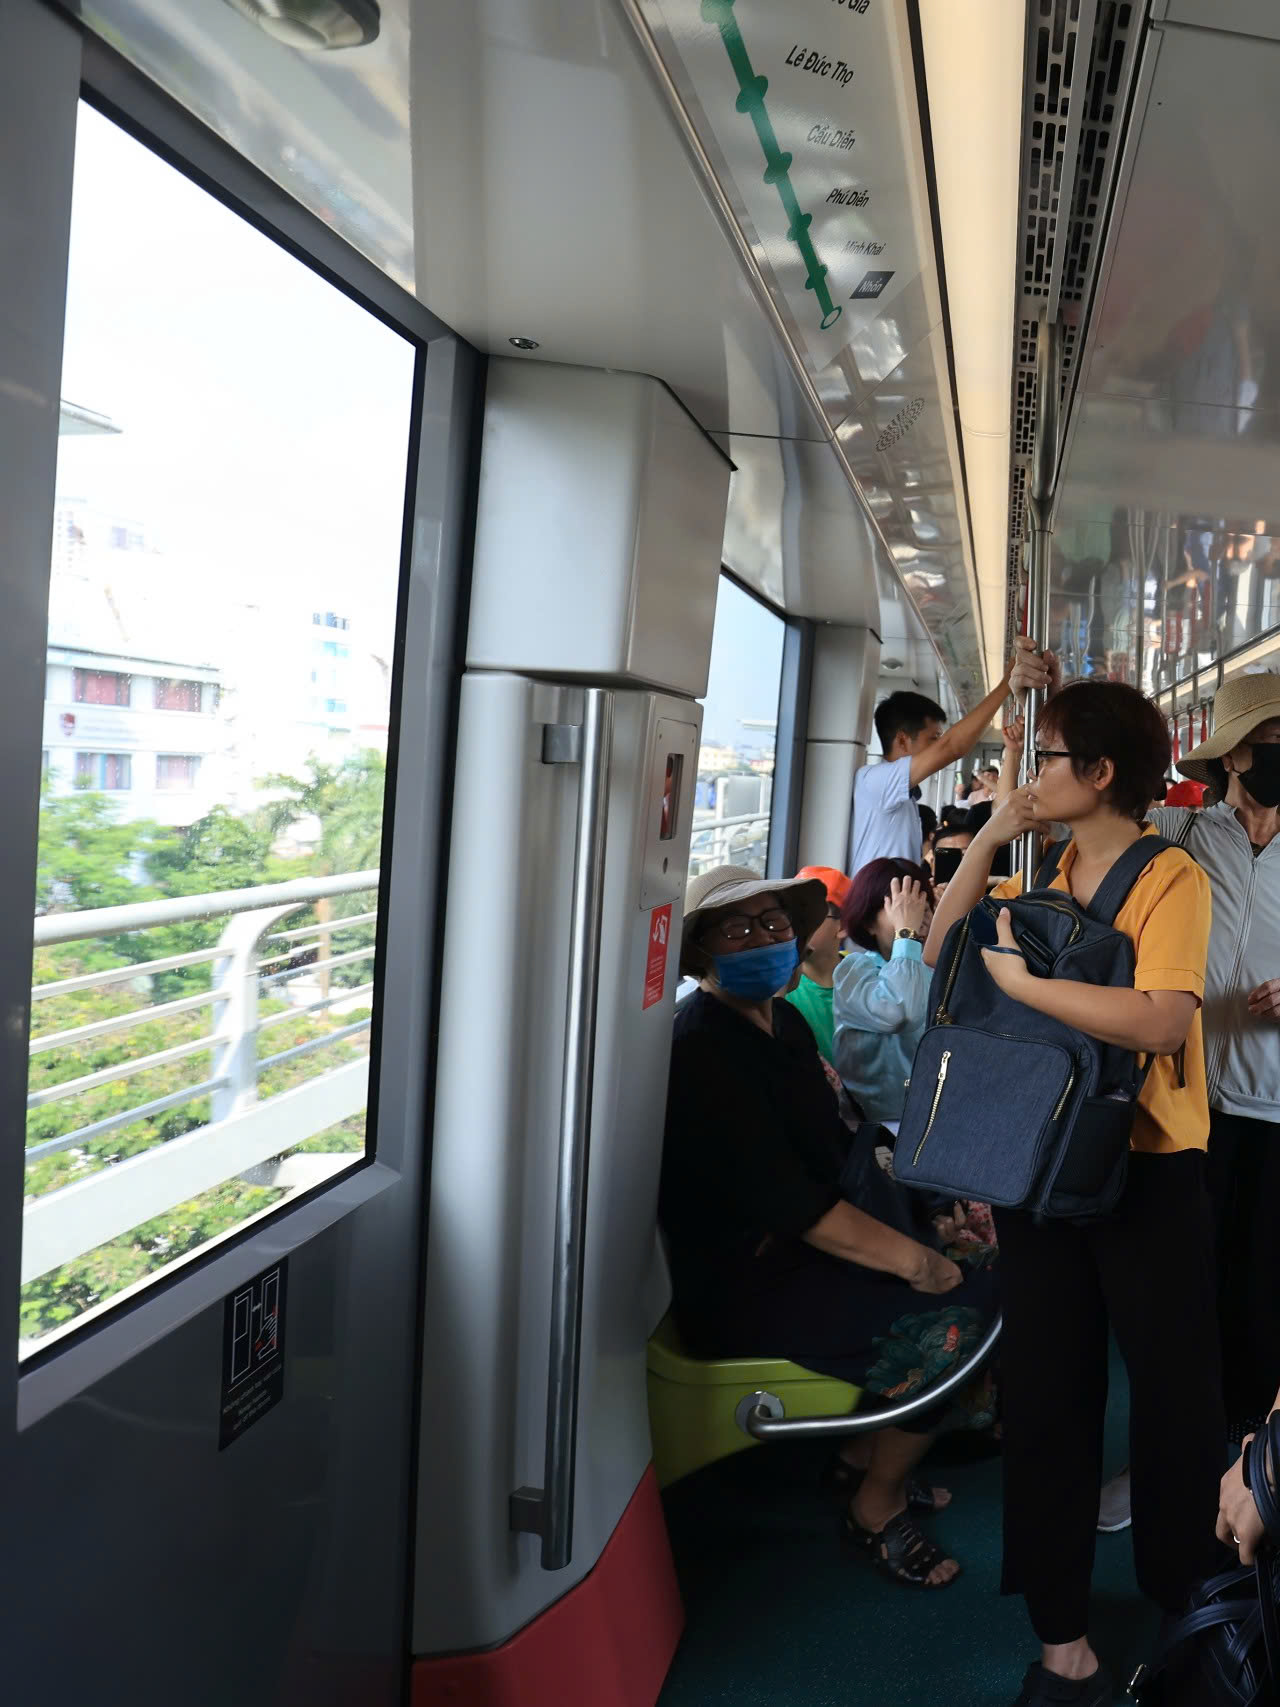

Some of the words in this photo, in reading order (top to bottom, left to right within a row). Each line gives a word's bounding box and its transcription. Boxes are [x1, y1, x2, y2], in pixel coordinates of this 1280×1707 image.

[785, 45, 807, 67] Lê
[803, 51, 832, 76] Đức
[831, 61, 854, 88] Thọ
[826, 188, 850, 205] Phú
[846, 190, 869, 208] Diễn
